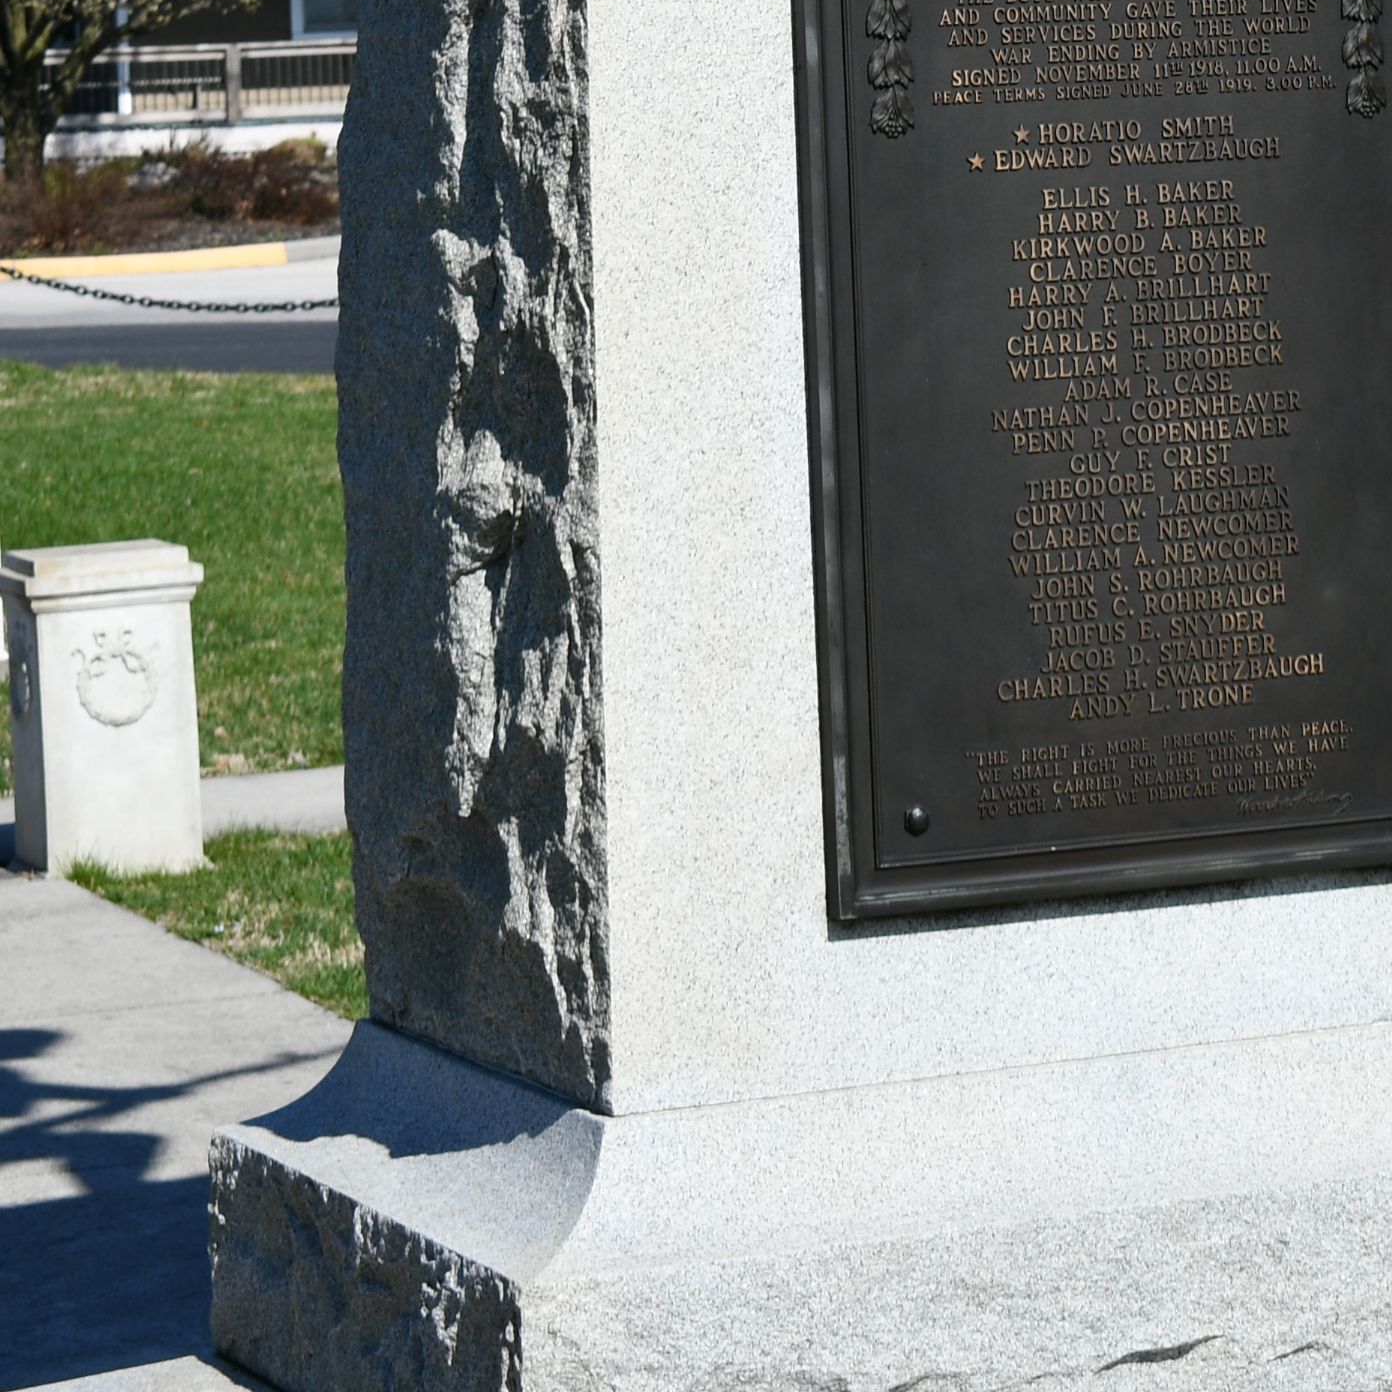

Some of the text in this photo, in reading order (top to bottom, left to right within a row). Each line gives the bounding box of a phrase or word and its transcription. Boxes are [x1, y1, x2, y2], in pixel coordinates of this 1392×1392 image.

[939, 8, 980, 26] AND
[994, 4, 1112, 24] COMMUNITY
[1127, 1, 1176, 19] GAVE
[1188, 0, 1247, 16] THEIR
[948, 17, 1310, 46] AND SERVICES DURING THE WORLD
[991, 38, 1271, 65] WAR ENDING BY ARMISTICE
[952, 68, 1021, 87] SIGNED
[1036, 64, 1139, 84] NOVEMBER
[1287, 55, 1322, 73] A.M.
[933, 90, 983, 105] PEACE
[993, 87, 1045, 103] TERMS
[1057, 85, 1111, 100] SIGNED
[1121, 83, 1162, 97] JUNE
[1308, 75, 1336, 88] P.M.
[1039, 116, 1234, 145] HORATIO SMITH
[994, 138, 1280, 171] EDWARD SWARTZBAUGH
[1042, 180, 1234, 209] ELLIS H. BAKER
[1038, 204, 1241, 235] HARRY B. BAKER
[1013, 227, 1267, 260] KIRKWOOD A. BAKER
[1030, 252, 1252, 282] CLARENCE BOYER
[1008, 273, 1270, 308] HARRY A. BRILLHART
[1022, 297, 1263, 331] JOHN F. BRILLHART
[1007, 321, 1282, 356] CHARLES H. BRODBECK
[1009, 345, 1284, 381] WILLIAM F. BRODBECK
[1065, 371, 1232, 402] ADAM R. CASE
[993, 391, 1301, 431] NATHAN J. COPENHEAVER
[1012, 416, 1290, 453] PENN P. COPENHEAVER
[1070, 444, 1231, 474] GUY F. CRIST
[1026, 465, 1276, 502] THEODORE KESSLER
[1015, 488, 1289, 528] CURVIN W. LAUGHMAN
[1011, 512, 1293, 552] CLARENCE NEWCOMER
[1010, 536, 1299, 577] WILLIAM A. NEWCOMER
[1031, 561, 1282, 599] JOHN S. ROHRBAUGH
[1029, 585, 1287, 625] TITUS C. ROHRBAUGH
[1050, 611, 1265, 648] RUFUS E. SNYDER
[1041, 634, 1276, 674] JACOB D. STAUFFER
[997, 653, 1324, 702] CHARLES H. SWARTZBAUGH
[1069, 685, 1254, 720] ANDY L. TRONE
[977, 737, 1348, 784] WE SHALL FIGHT FOR THE THINGS WE HAVE
[1021, 745, 1069, 763] RIGHT
[1080, 743, 1095, 757] IS
[1107, 738, 1149, 755] MORE
[1162, 730, 1237, 749] PRECIOUS
[1249, 725, 1291, 741] THAN
[978, 804, 998, 819] TO
[1008, 799, 1045, 815] SUCH
[1053, 798, 1063, 811] A
[1070, 794, 1106, 810] TASK
[1115, 791, 1138, 805] WE
[1149, 783, 1218, 802] DEDICATE
[1228, 780, 1255, 794] OUR
[980, 783, 1040, 802] ALWAYS
[1053, 776, 1122, 795] CARRIED
[1133, 768, 1201, 787] NEAREST
[1212, 765, 1242, 779] OUR
